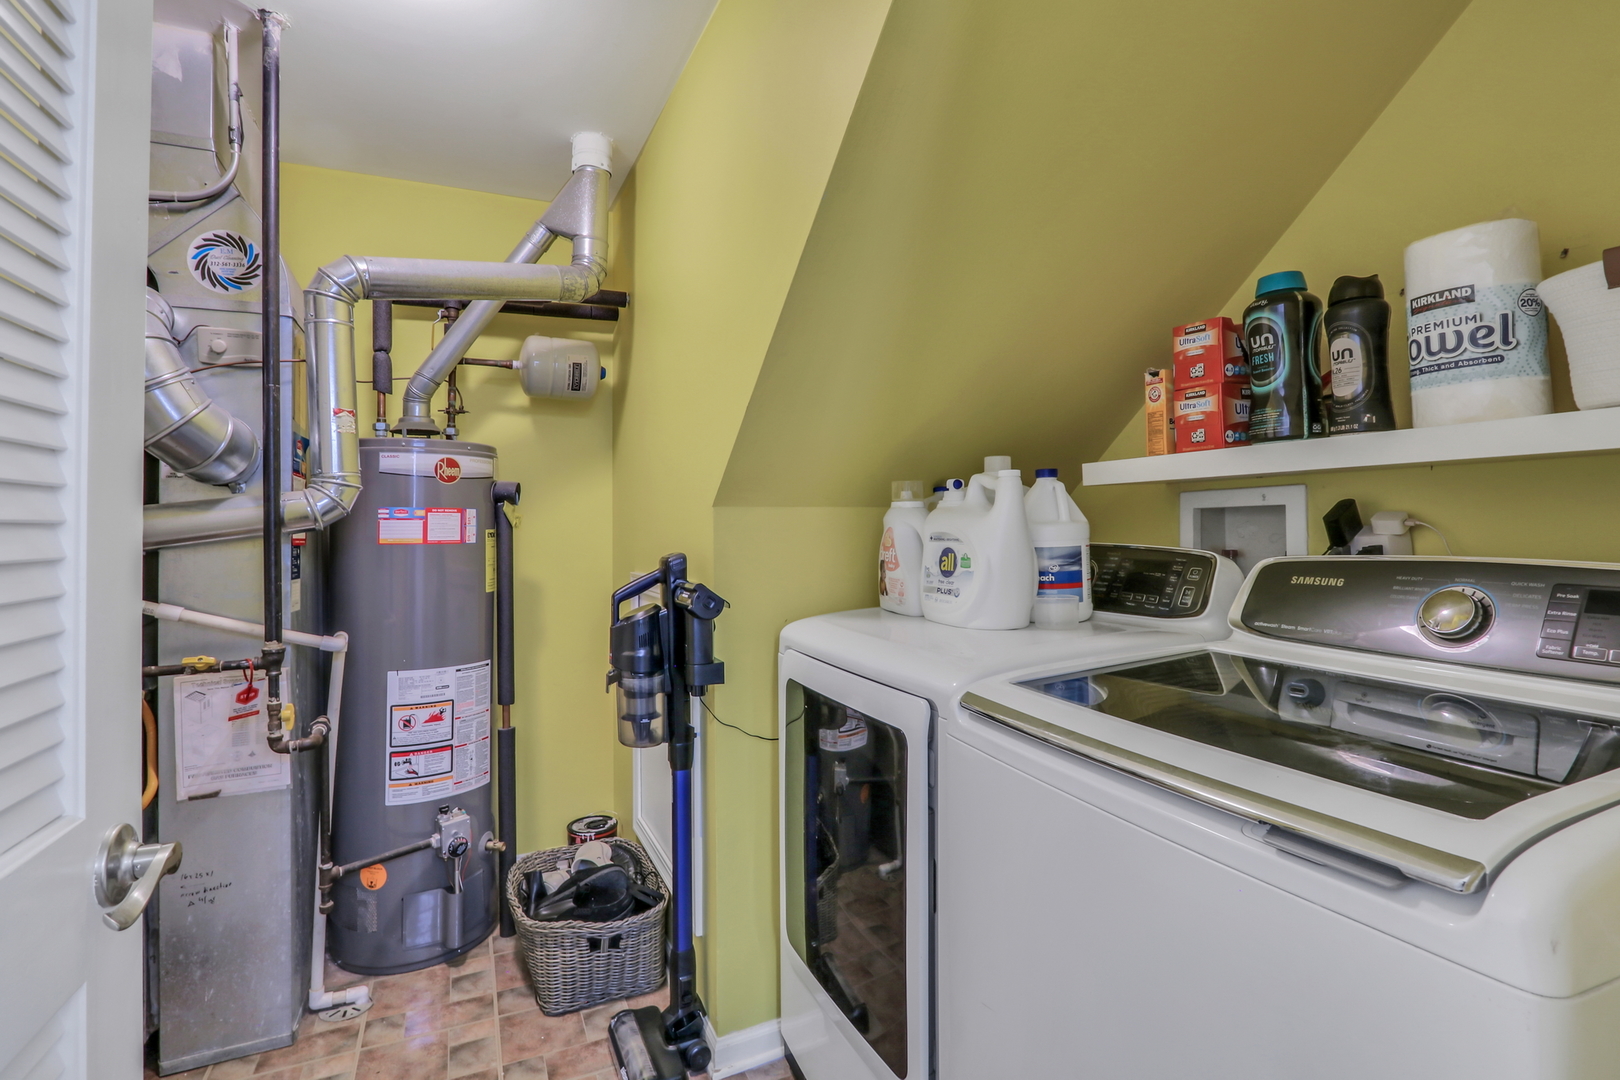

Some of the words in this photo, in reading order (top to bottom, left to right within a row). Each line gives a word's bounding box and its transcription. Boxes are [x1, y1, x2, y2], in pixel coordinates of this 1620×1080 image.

[1412, 287, 1471, 309] KIRKLAND
[1520, 298, 1540, 308] 20%
[1185, 325, 1206, 333] KIRKLAND
[1411, 314, 1477, 335] PREMIUM
[1179, 334, 1210, 346] UltraSoft
[1250, 333, 1274, 348] un
[1409, 313, 1514, 362] owel
[1252, 352, 1275, 366] FRESH
[1332, 347, 1353, 362] un
[1458, 356, 1501, 367] Absorbent
[1185, 390, 1206, 398] KIRKLAND
[1180, 399, 1211, 411] UltraSoft
[437, 458, 460, 480] Rheem
[940, 552, 954, 571] all
[1291, 576, 1345, 587] SAMSUNG
